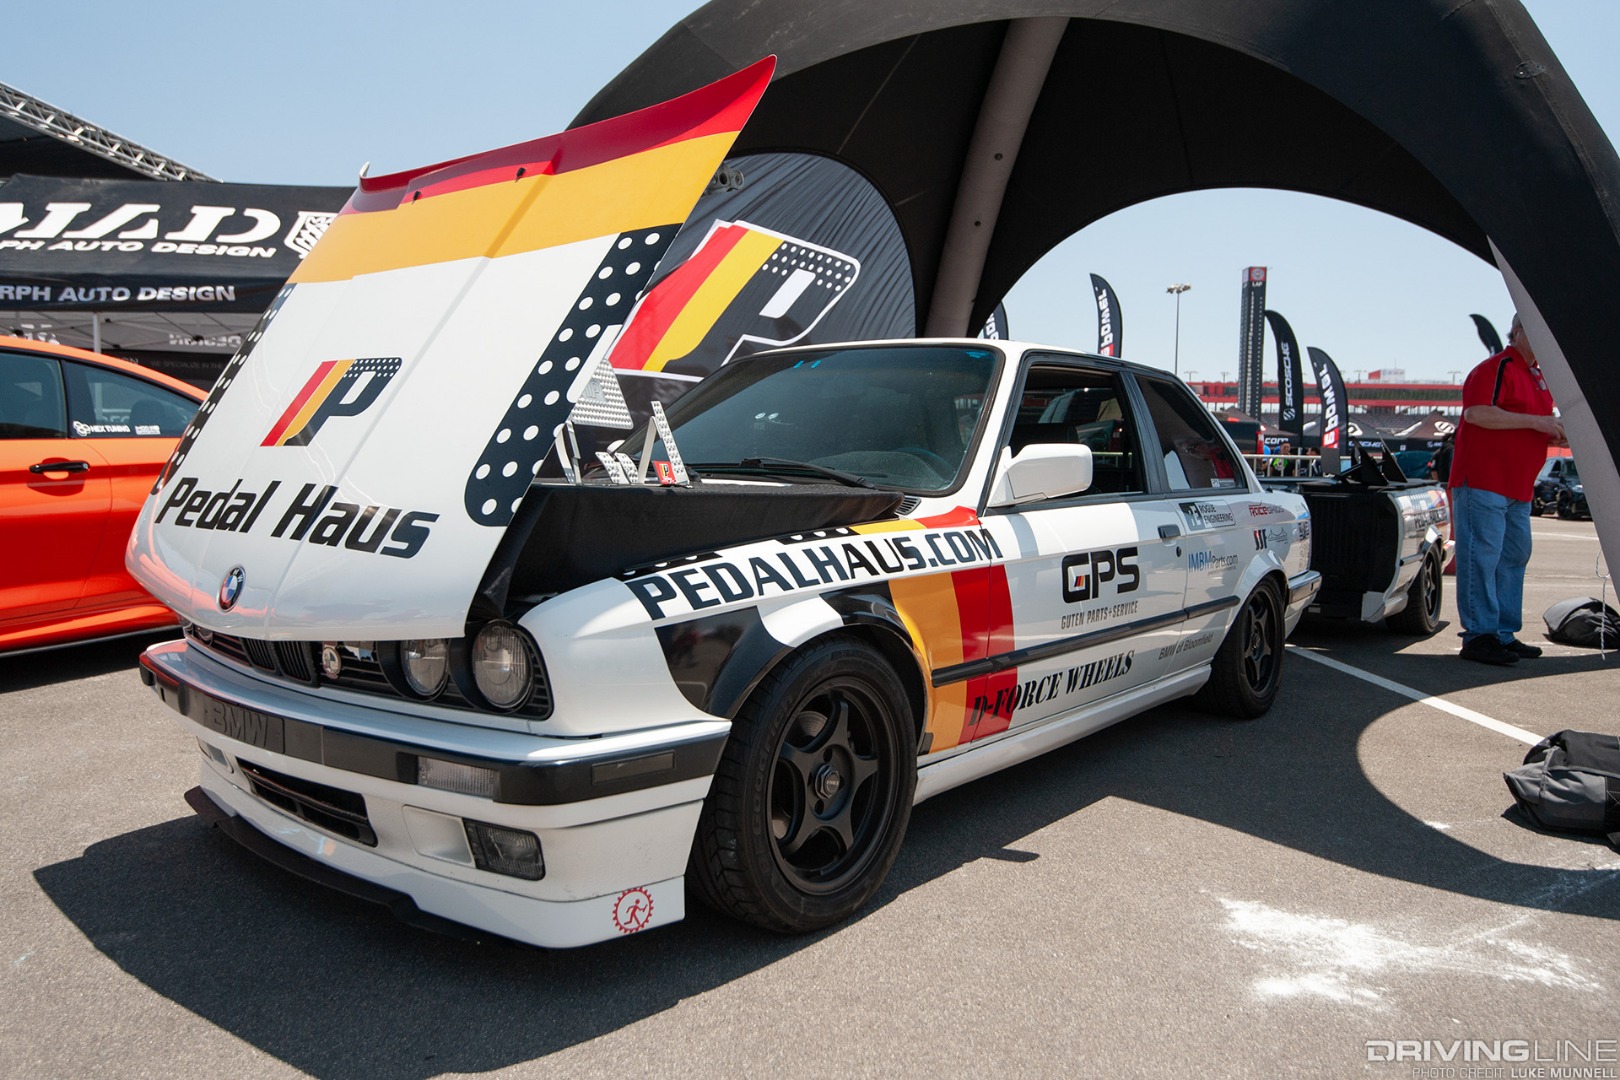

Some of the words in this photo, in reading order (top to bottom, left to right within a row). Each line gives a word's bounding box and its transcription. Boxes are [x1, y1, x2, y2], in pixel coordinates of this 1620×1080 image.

[47, 240, 144, 251] AUTO
[150, 242, 277, 258] DESIGN
[58, 286, 131, 302] AUTO
[136, 286, 236, 301] DESIGN
[1281, 342, 1293, 407] SCOSCHE
[154, 477, 282, 533] Pedal
[270, 483, 441, 559] Haus
[1199, 504, 1217, 514] ROGUE
[1203, 512, 1233, 525] ENGINEERING
[623, 528, 1003, 620] PEDALHAUS.COM
[1061, 546, 1140, 604] GPS
[1060, 615, 1085, 630] GUTEN
[1158, 643, 1177, 660] BMW
[967, 671, 1063, 727] D-FORCE
[1066, 649, 1136, 694] WHEELS
[212, 702, 269, 747] BMW
